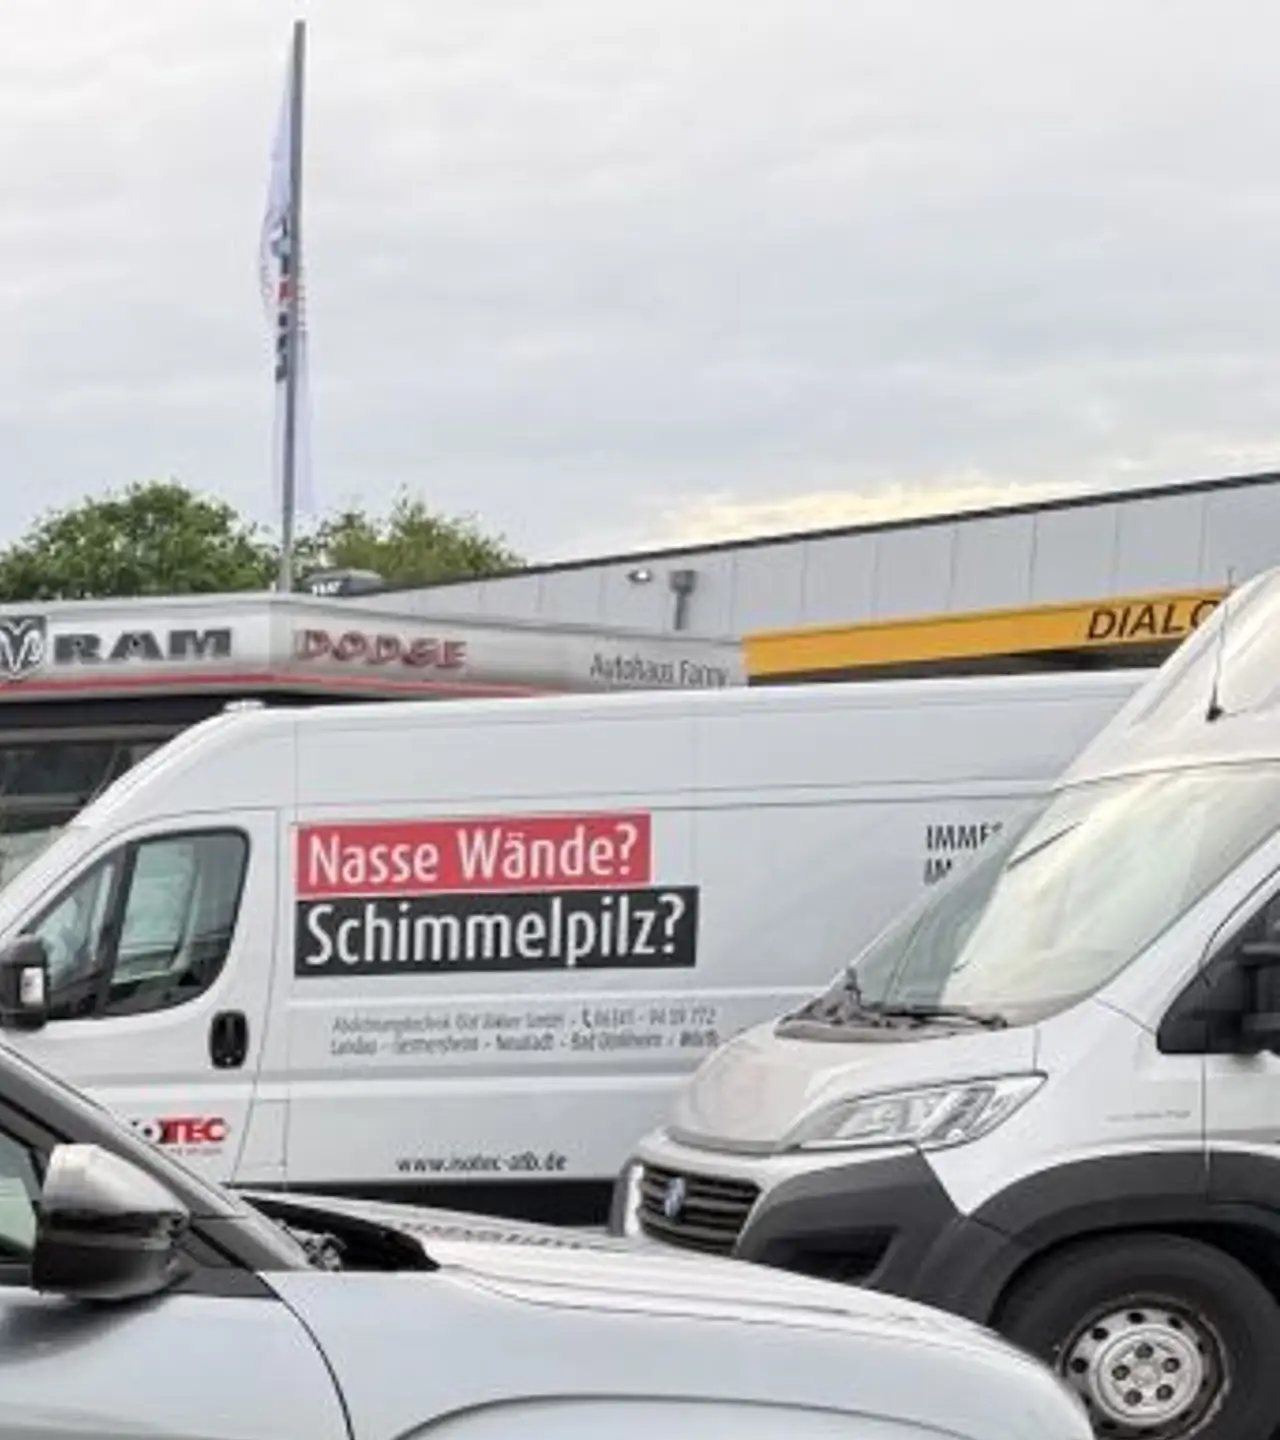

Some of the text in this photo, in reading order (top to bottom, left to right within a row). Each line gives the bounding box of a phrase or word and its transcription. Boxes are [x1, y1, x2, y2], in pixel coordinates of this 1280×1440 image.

[53, 628, 232, 665] RAM
[293, 629, 468, 669] DODGE
[590, 653, 674, 685] Autohaus
[308, 823, 639, 886] Nasse Wände?
[305, 894, 686, 967] Schimmelpilz?
